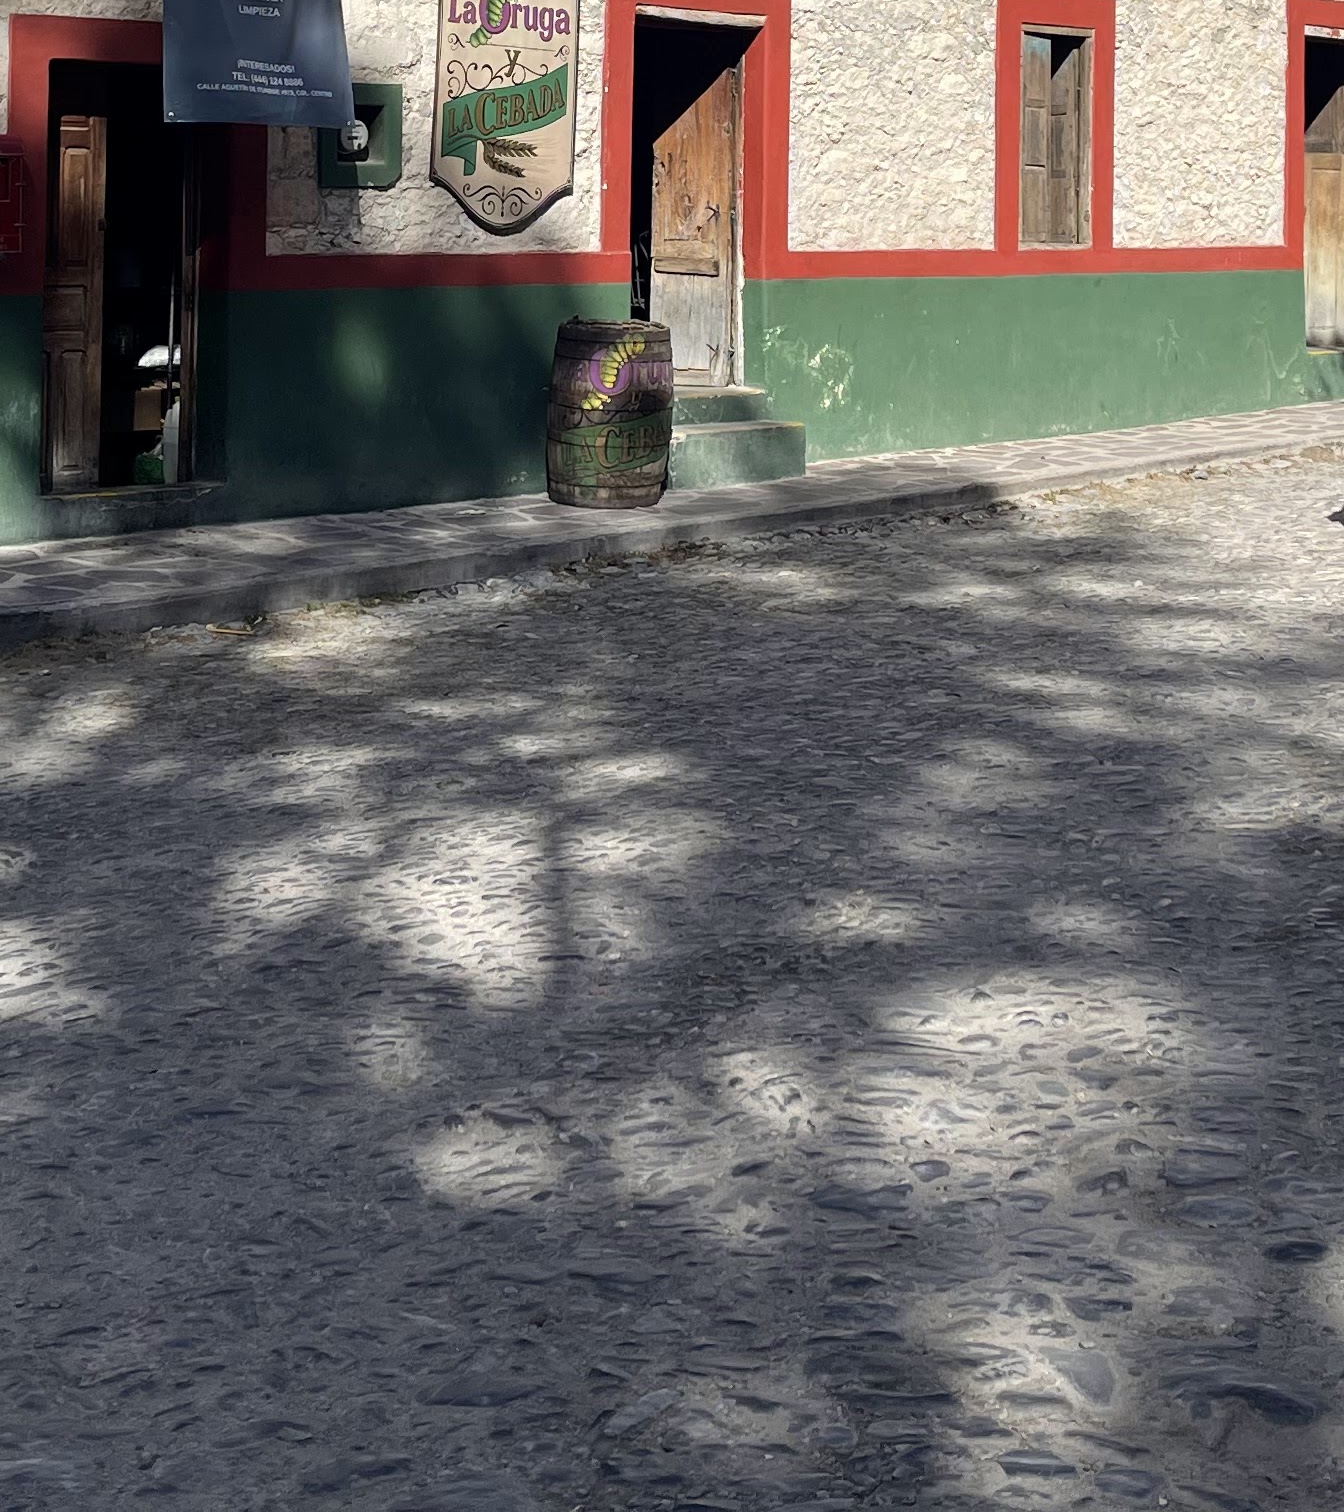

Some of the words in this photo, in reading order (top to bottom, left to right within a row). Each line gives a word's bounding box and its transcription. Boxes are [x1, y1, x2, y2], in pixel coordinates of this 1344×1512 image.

[238, 4, 281, 17] LIMPIEZA
[447, 103, 473, 138] LA
[473, 77, 567, 138] CEBADA
